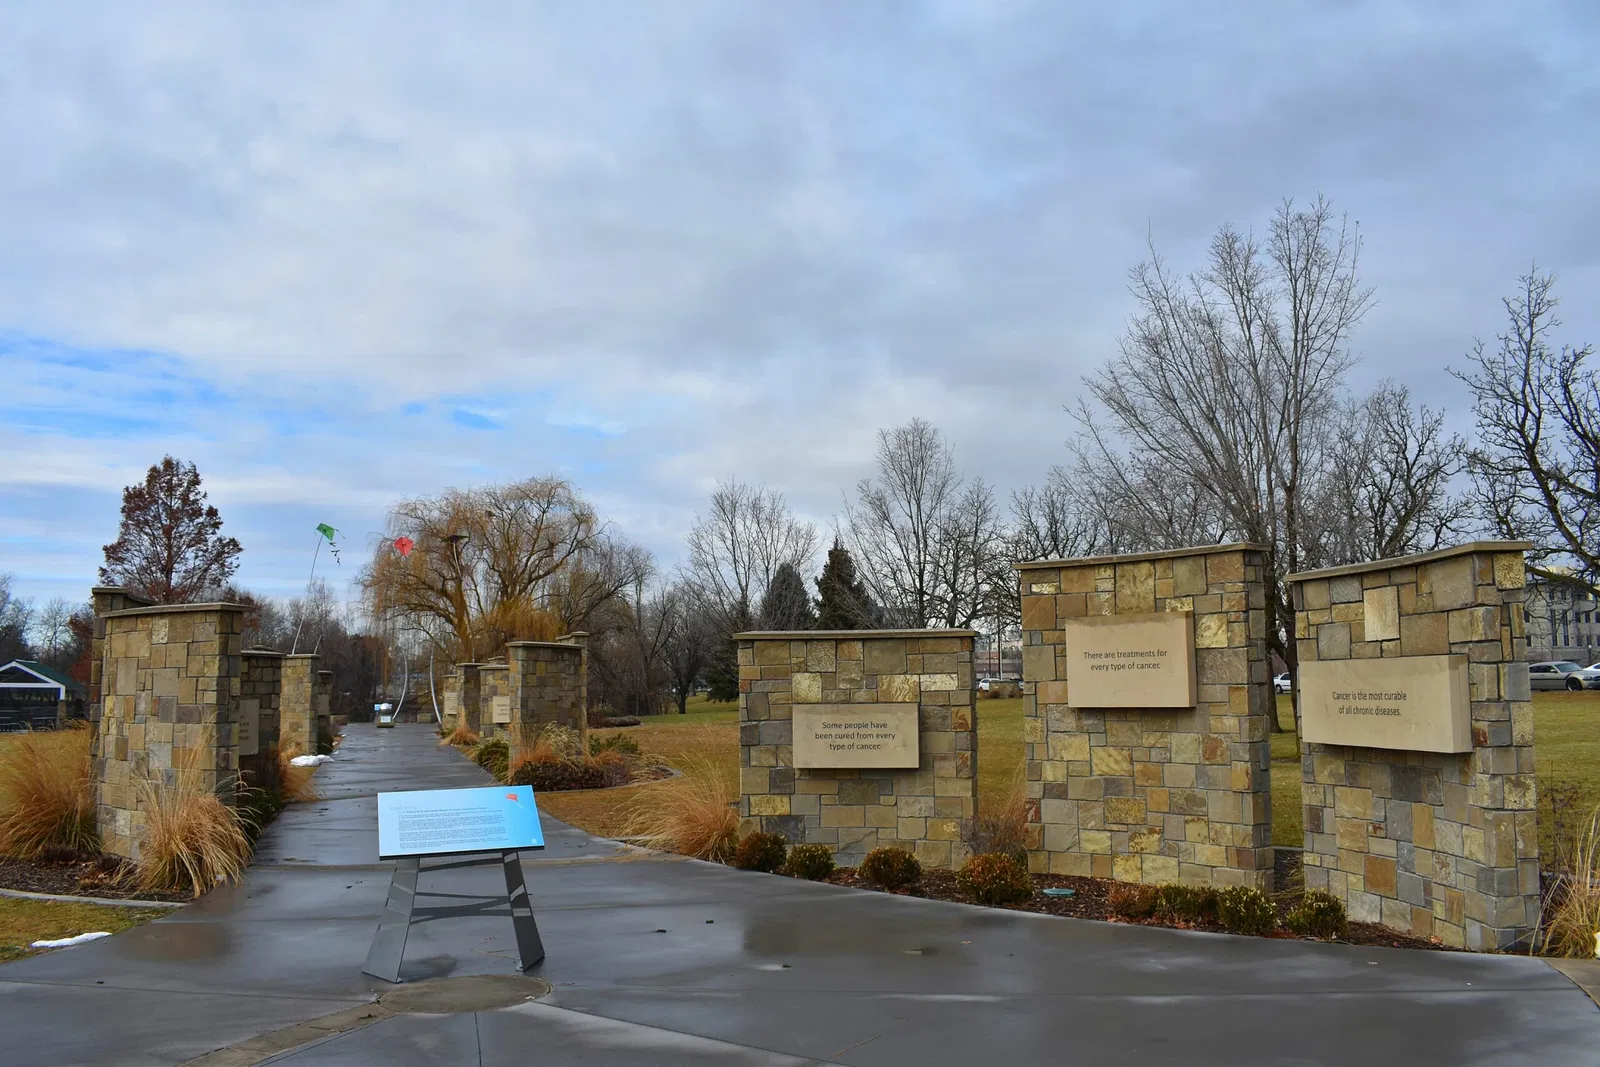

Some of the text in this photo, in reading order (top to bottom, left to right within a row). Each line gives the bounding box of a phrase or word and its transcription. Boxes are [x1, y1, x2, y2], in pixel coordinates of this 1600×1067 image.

[1116, 650, 1156, 658] treatments
[1156, 649, 1168, 657] for
[1110, 663, 1126, 671] type
[1332, 690, 1407, 700] Cancer is the most curable
[1338, 704, 1345, 714] of
[1353, 705, 1374, 715] chronic
[1374, 706, 1402, 716] diseases.
[844, 721, 869, 730] people
